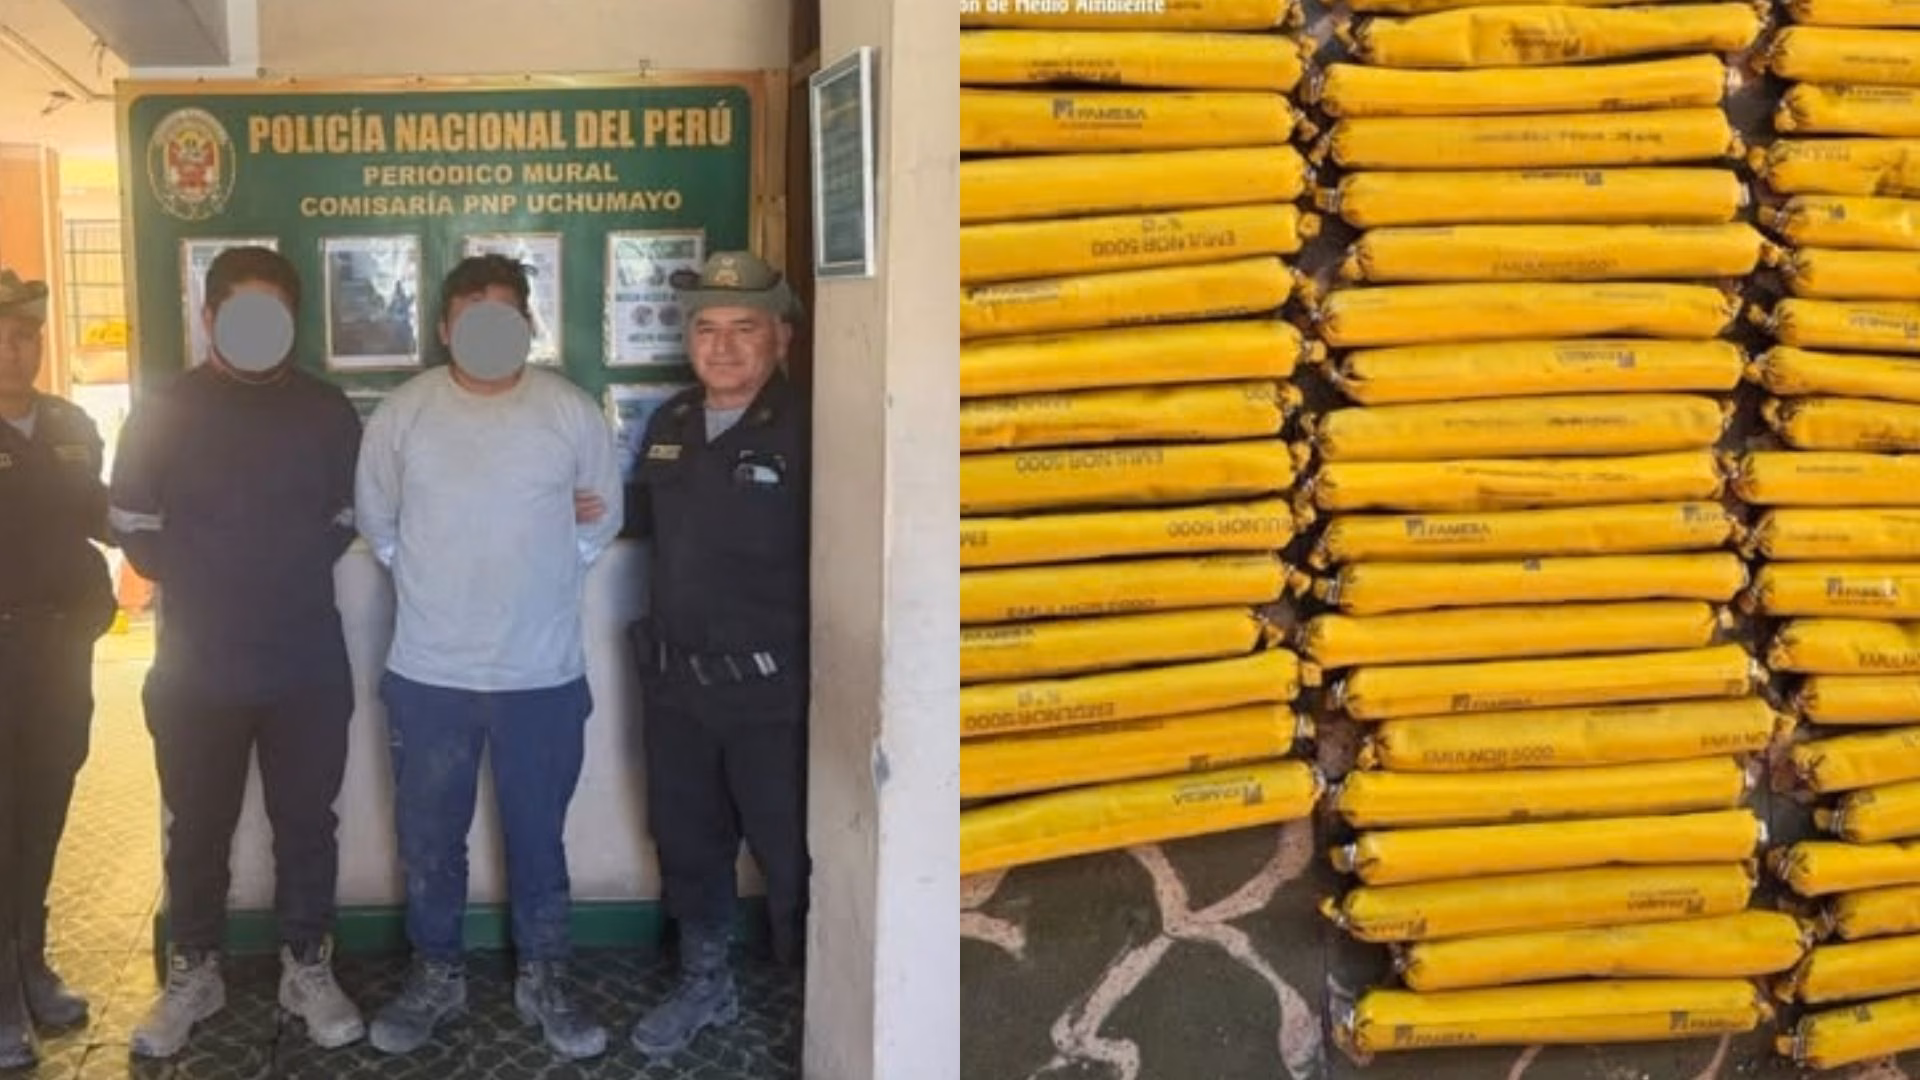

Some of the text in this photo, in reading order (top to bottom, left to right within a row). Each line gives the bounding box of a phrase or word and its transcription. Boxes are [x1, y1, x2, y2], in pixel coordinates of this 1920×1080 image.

[248, 99, 732, 153] POLICÍA NACIONAL DEL PERÚ
[363, 161, 619, 186] PERIÓDICO MURAL
[300, 190, 683, 217] COMISARÍA PNP UCHUMAYO
[1091, 238, 1139, 257] 5000
[1015, 456, 1063, 473] 5000
[1167, 520, 1214, 538] 5000
[964, 713, 1017, 731] 5000
